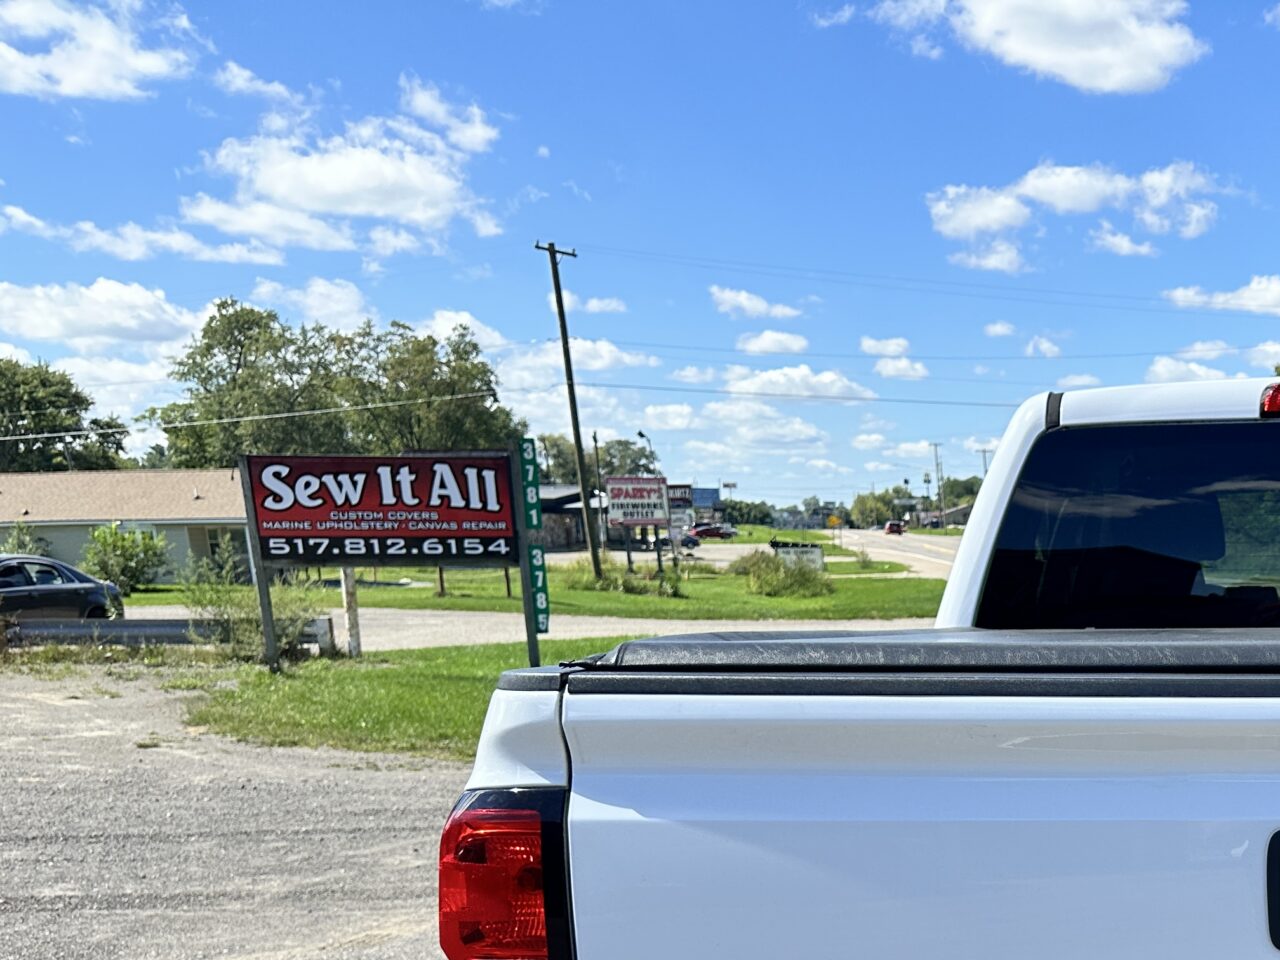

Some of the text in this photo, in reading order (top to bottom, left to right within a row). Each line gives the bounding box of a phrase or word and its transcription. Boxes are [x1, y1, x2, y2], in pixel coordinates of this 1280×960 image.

[260, 462, 501, 512] Sew It All
[522, 442, 538, 526] 3781
[610, 487, 664, 500] SPARKY'S
[611, 501, 664, 510] FIREWORKS
[329, 510, 439, 521] CUSTOM COVERS
[623, 510, 655, 518] OUTLET
[262, 520, 508, 531] MARINE UPHOLSTERY CANVAS REPAIR
[268, 537, 511, 555] 517.812.6154
[531, 549, 548, 630] 3785
